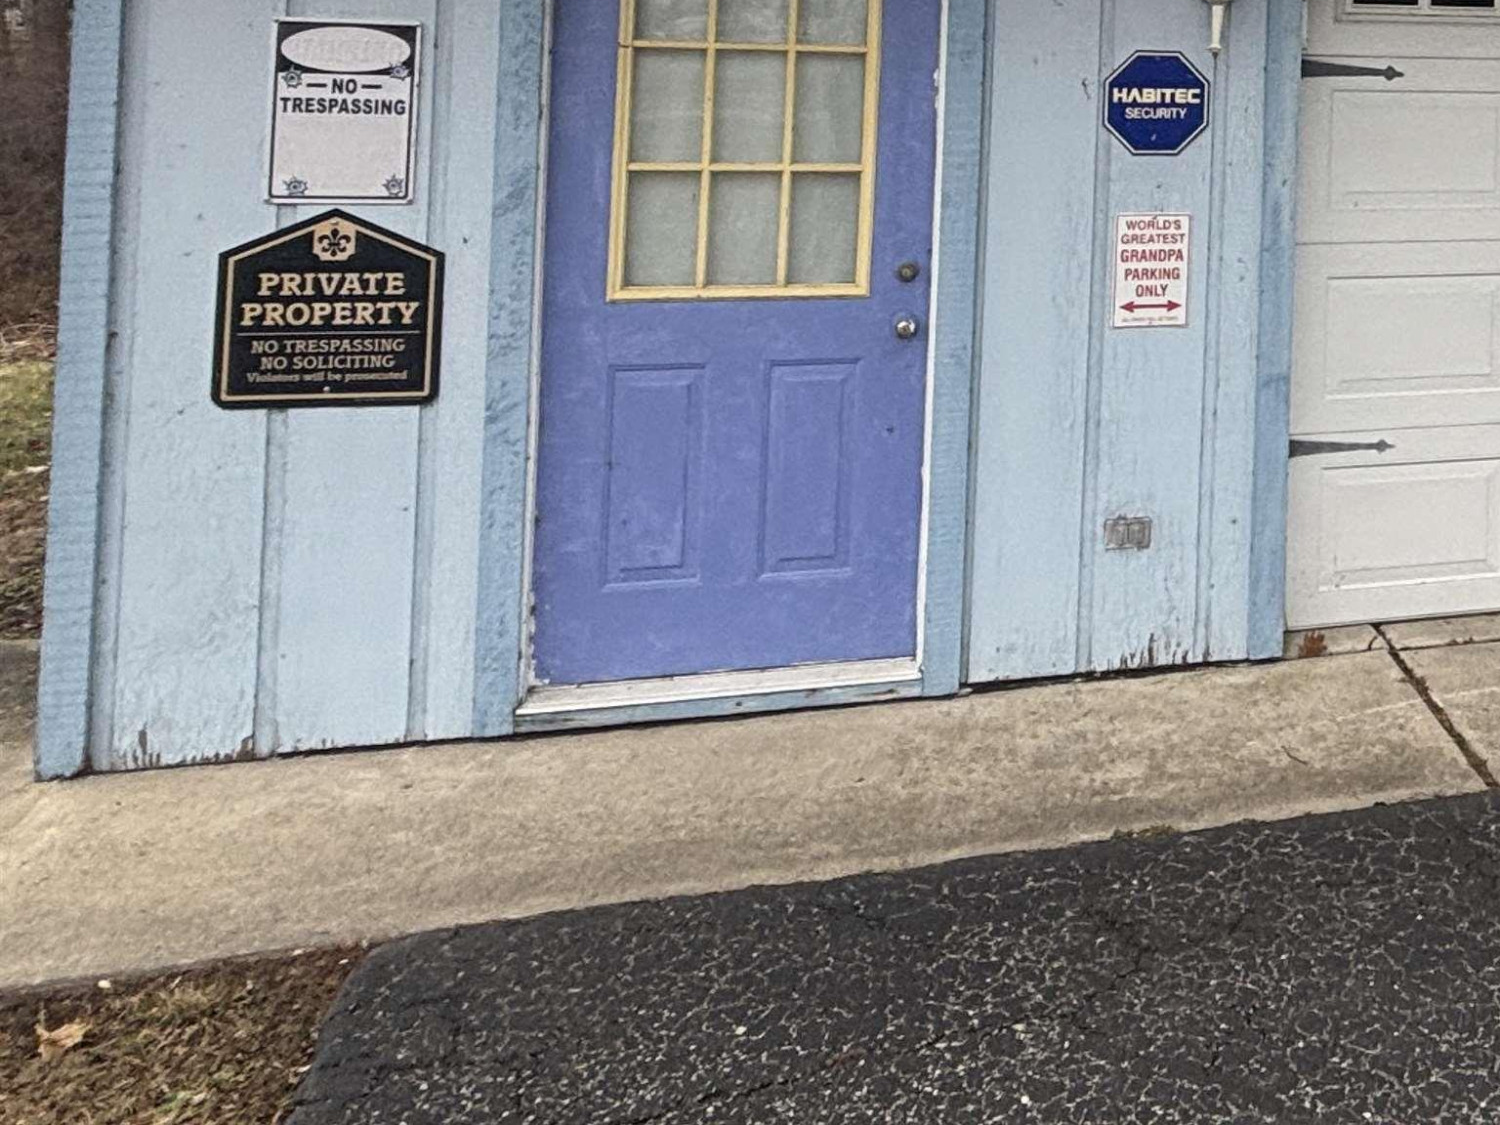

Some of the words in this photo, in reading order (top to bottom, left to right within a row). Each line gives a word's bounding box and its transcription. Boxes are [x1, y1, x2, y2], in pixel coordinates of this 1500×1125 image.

[331, 78, 358, 94] NO
[1113, 87, 1200, 104] HABITEC
[280, 97, 406, 115] TRESPASSING
[1125, 107, 1187, 119] SECURITY
[1126, 219, 1182, 231] WORLD'S
[1121, 233, 1186, 245] GREATEST
[1121, 248, 1184, 263] GRANDPA
[1124, 266, 1181, 281] PARKING
[257, 272, 406, 296] PRIVATE
[1135, 283, 1168, 297] ONLY
[239, 301, 420, 326] PROPERTY
[250, 340, 279, 354] NO
[283, 338, 406, 353] TRESPASSING
[260, 356, 288, 370] NO
[292, 355, 396, 369] SOLICITING
[302, 371, 326, 382] will
[327, 371, 342, 382] be
